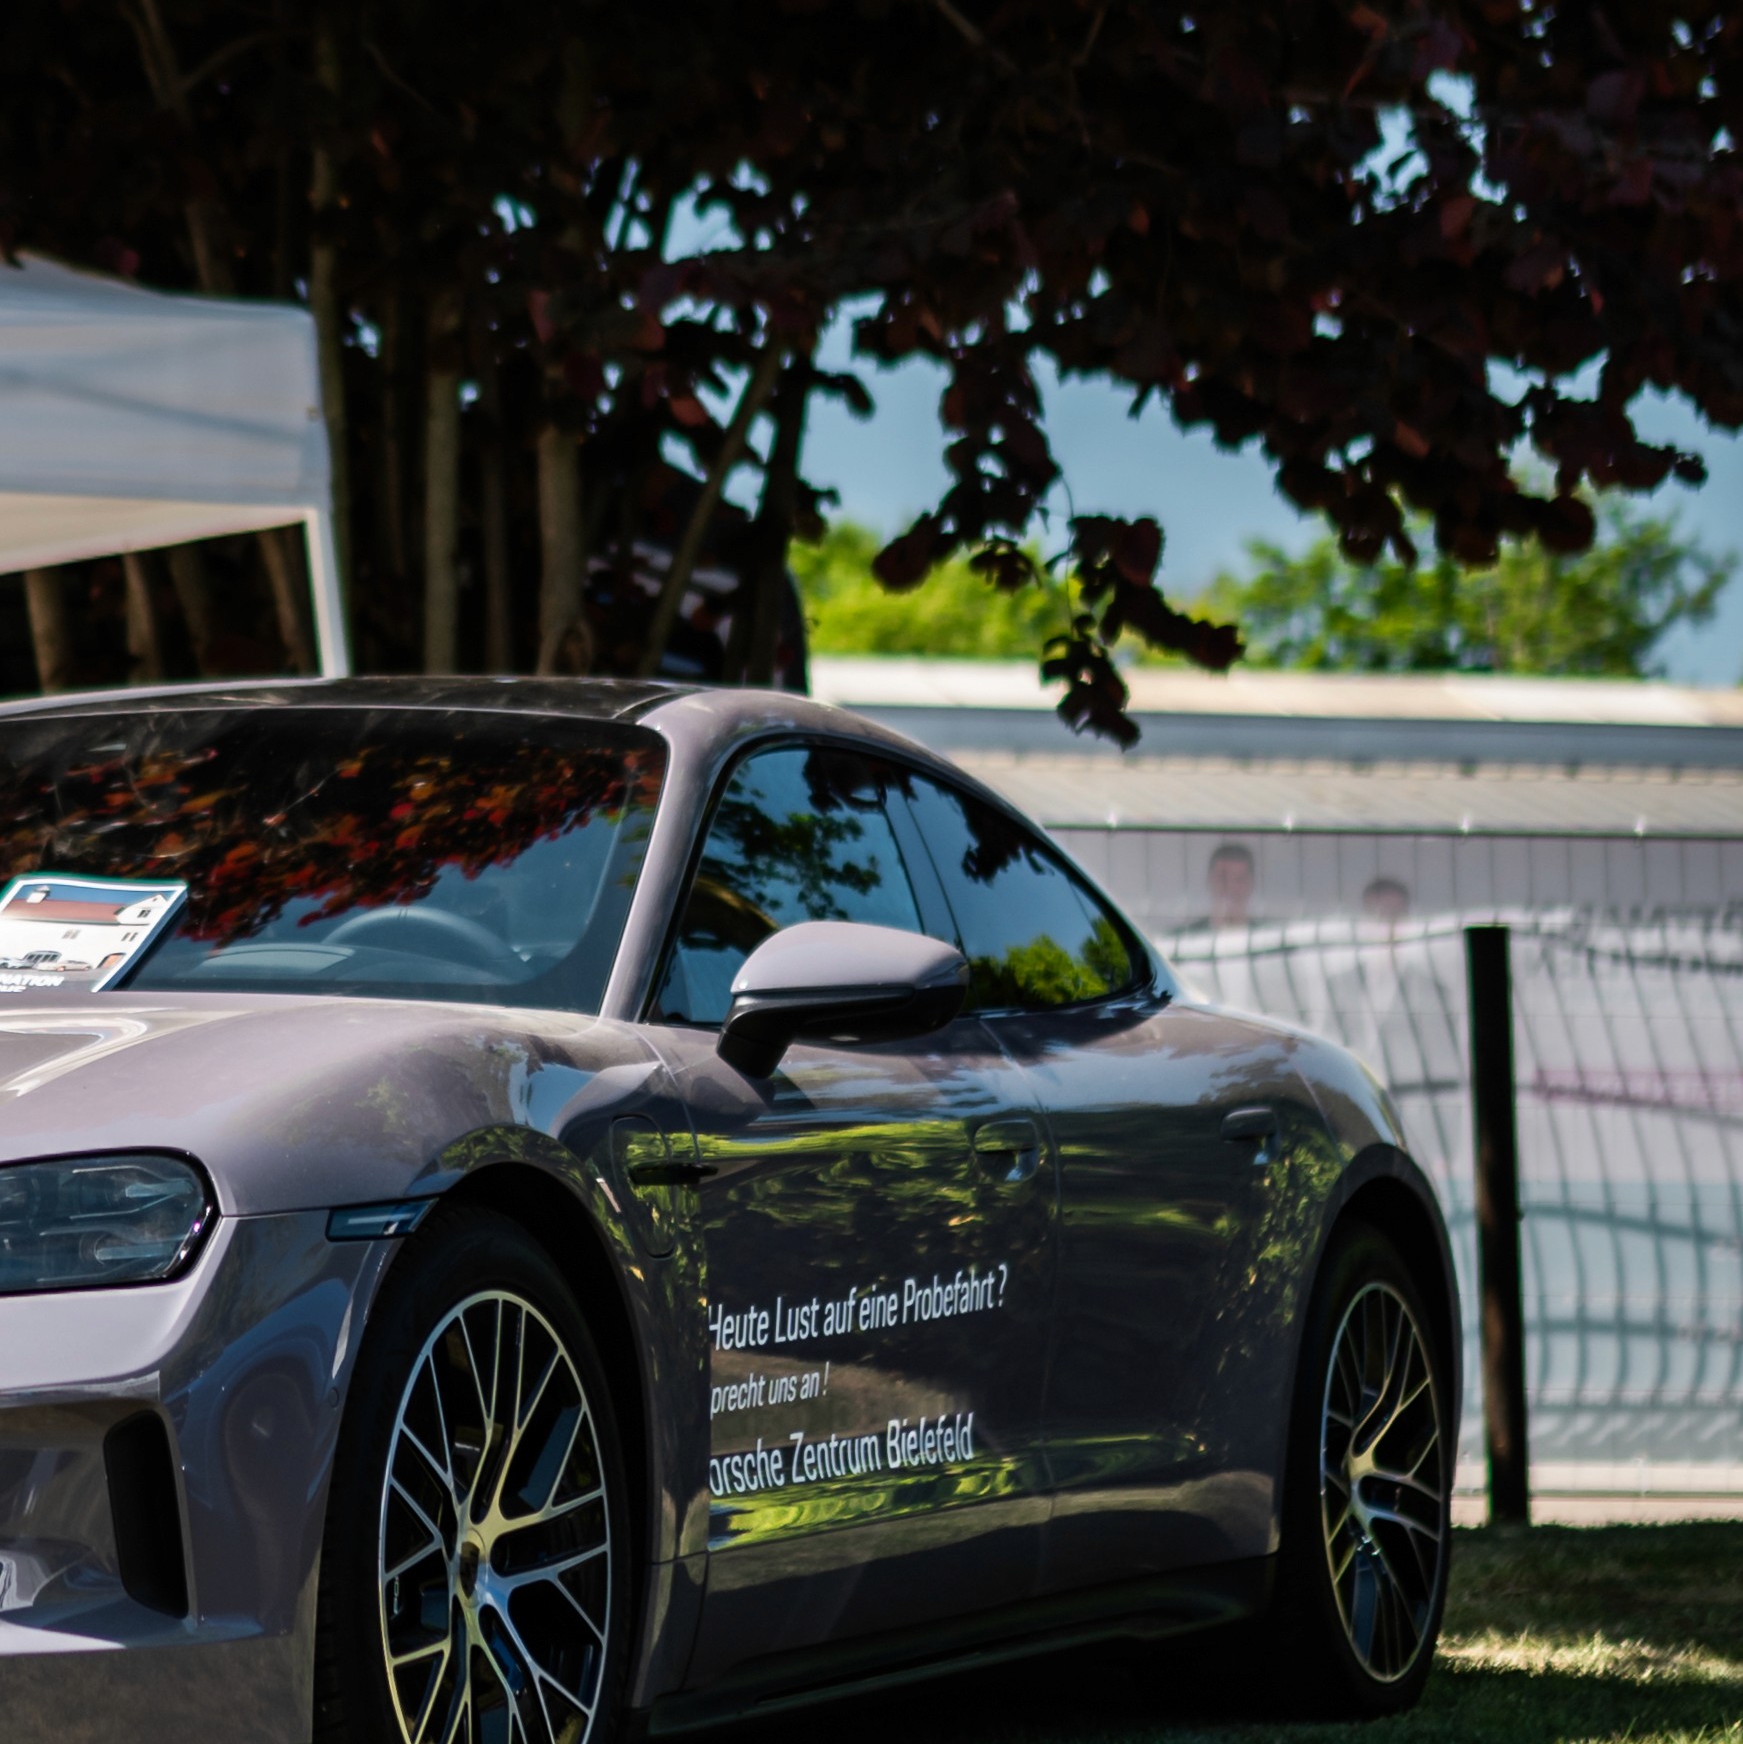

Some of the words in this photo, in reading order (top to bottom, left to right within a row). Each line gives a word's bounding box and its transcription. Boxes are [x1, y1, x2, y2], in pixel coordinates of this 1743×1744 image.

[709, 1303, 769, 1351] Heute
[774, 1296, 820, 1343] Lust
[823, 1287, 857, 1337] auf
[858, 1285, 898, 1332] eine
[710, 1372, 766, 1421] precht
[768, 1375, 797, 1405] uns
[709, 1438, 785, 1497] orsche
[789, 1431, 881, 1484] Zentrum
[887, 1411, 974, 1470] Bielefeld
